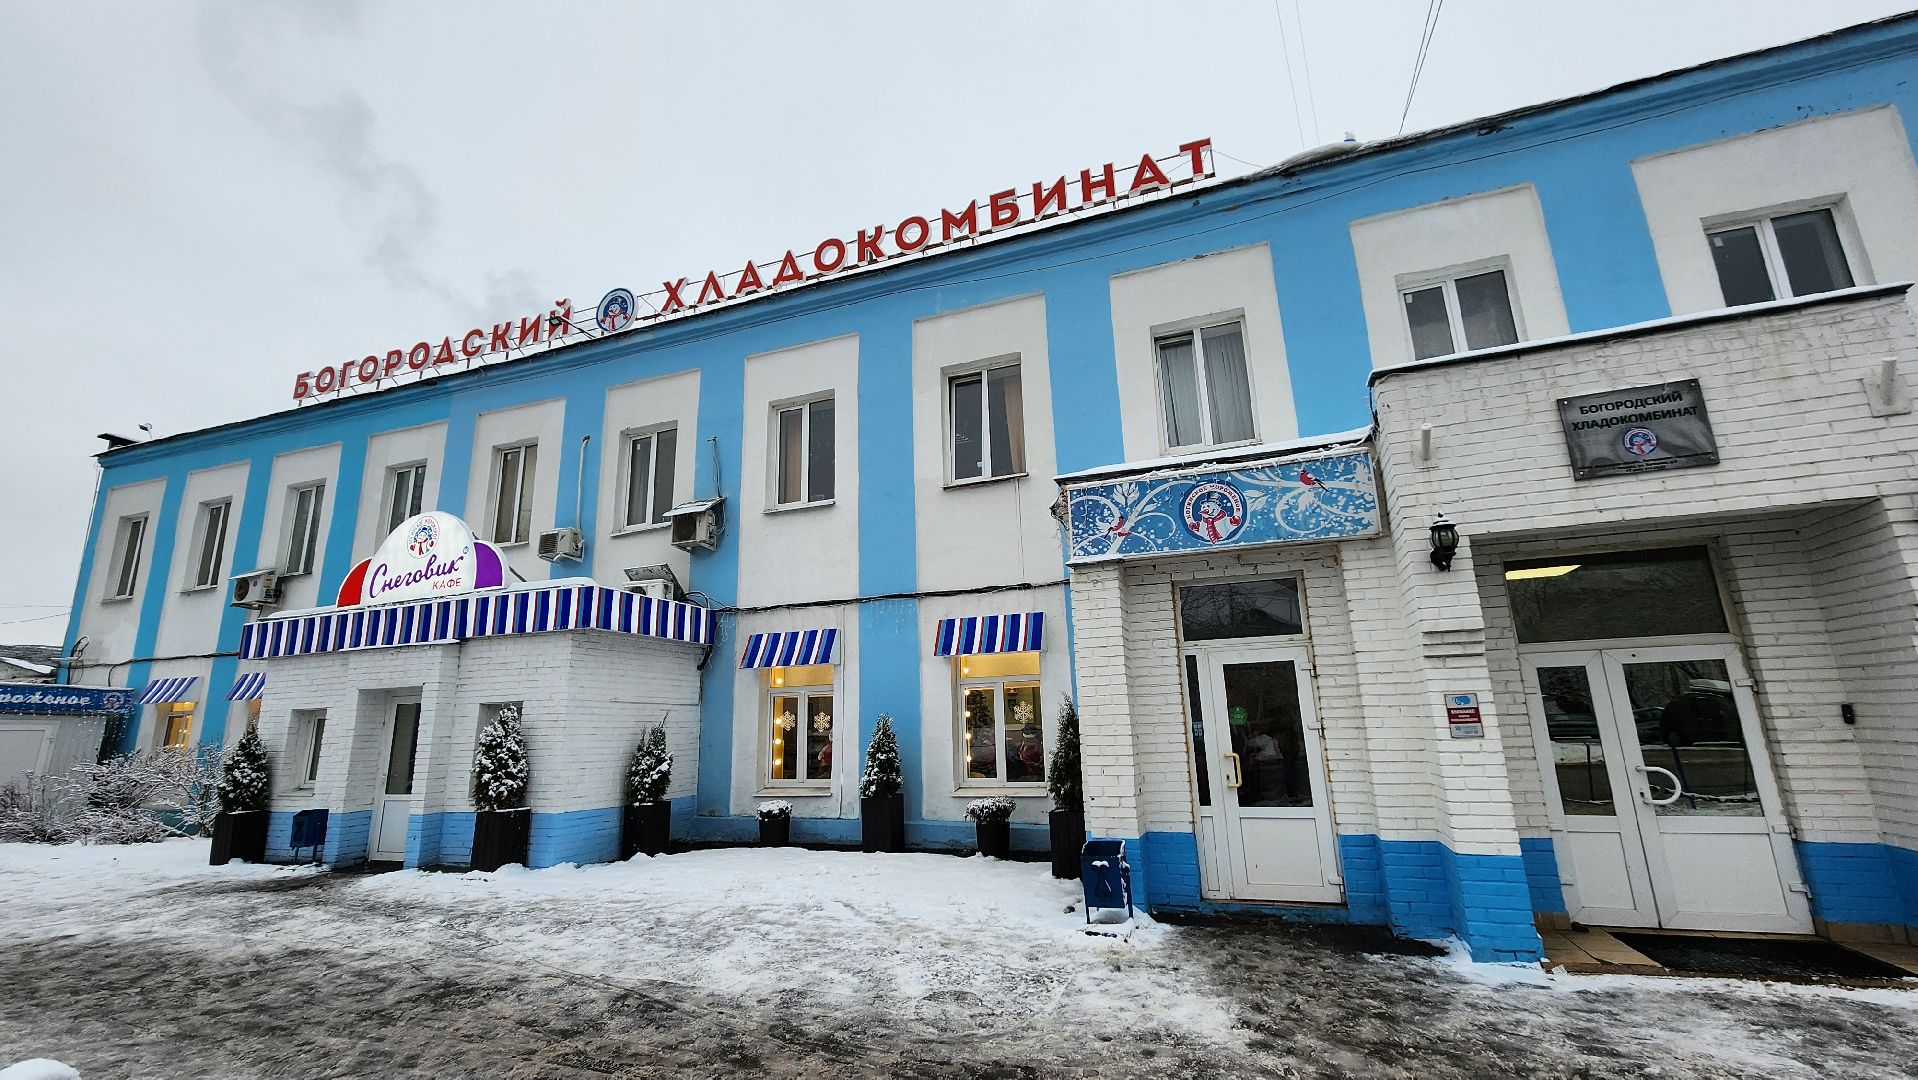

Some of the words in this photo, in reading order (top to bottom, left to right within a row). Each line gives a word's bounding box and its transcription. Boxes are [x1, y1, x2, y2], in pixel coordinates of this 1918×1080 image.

[293, 298, 575, 400] БОГОРОДСКИЙ
[661, 138, 1212, 314] ХЛАДОКОМБИНАТ
[1579, 390, 1683, 415] БОГОРОДСКИЙ
[1571, 406, 1698, 431] ХЛАДОКОМБИНАТ
[369, 554, 465, 599] Снеговик
[432, 578, 462, 591] КАФЕ
